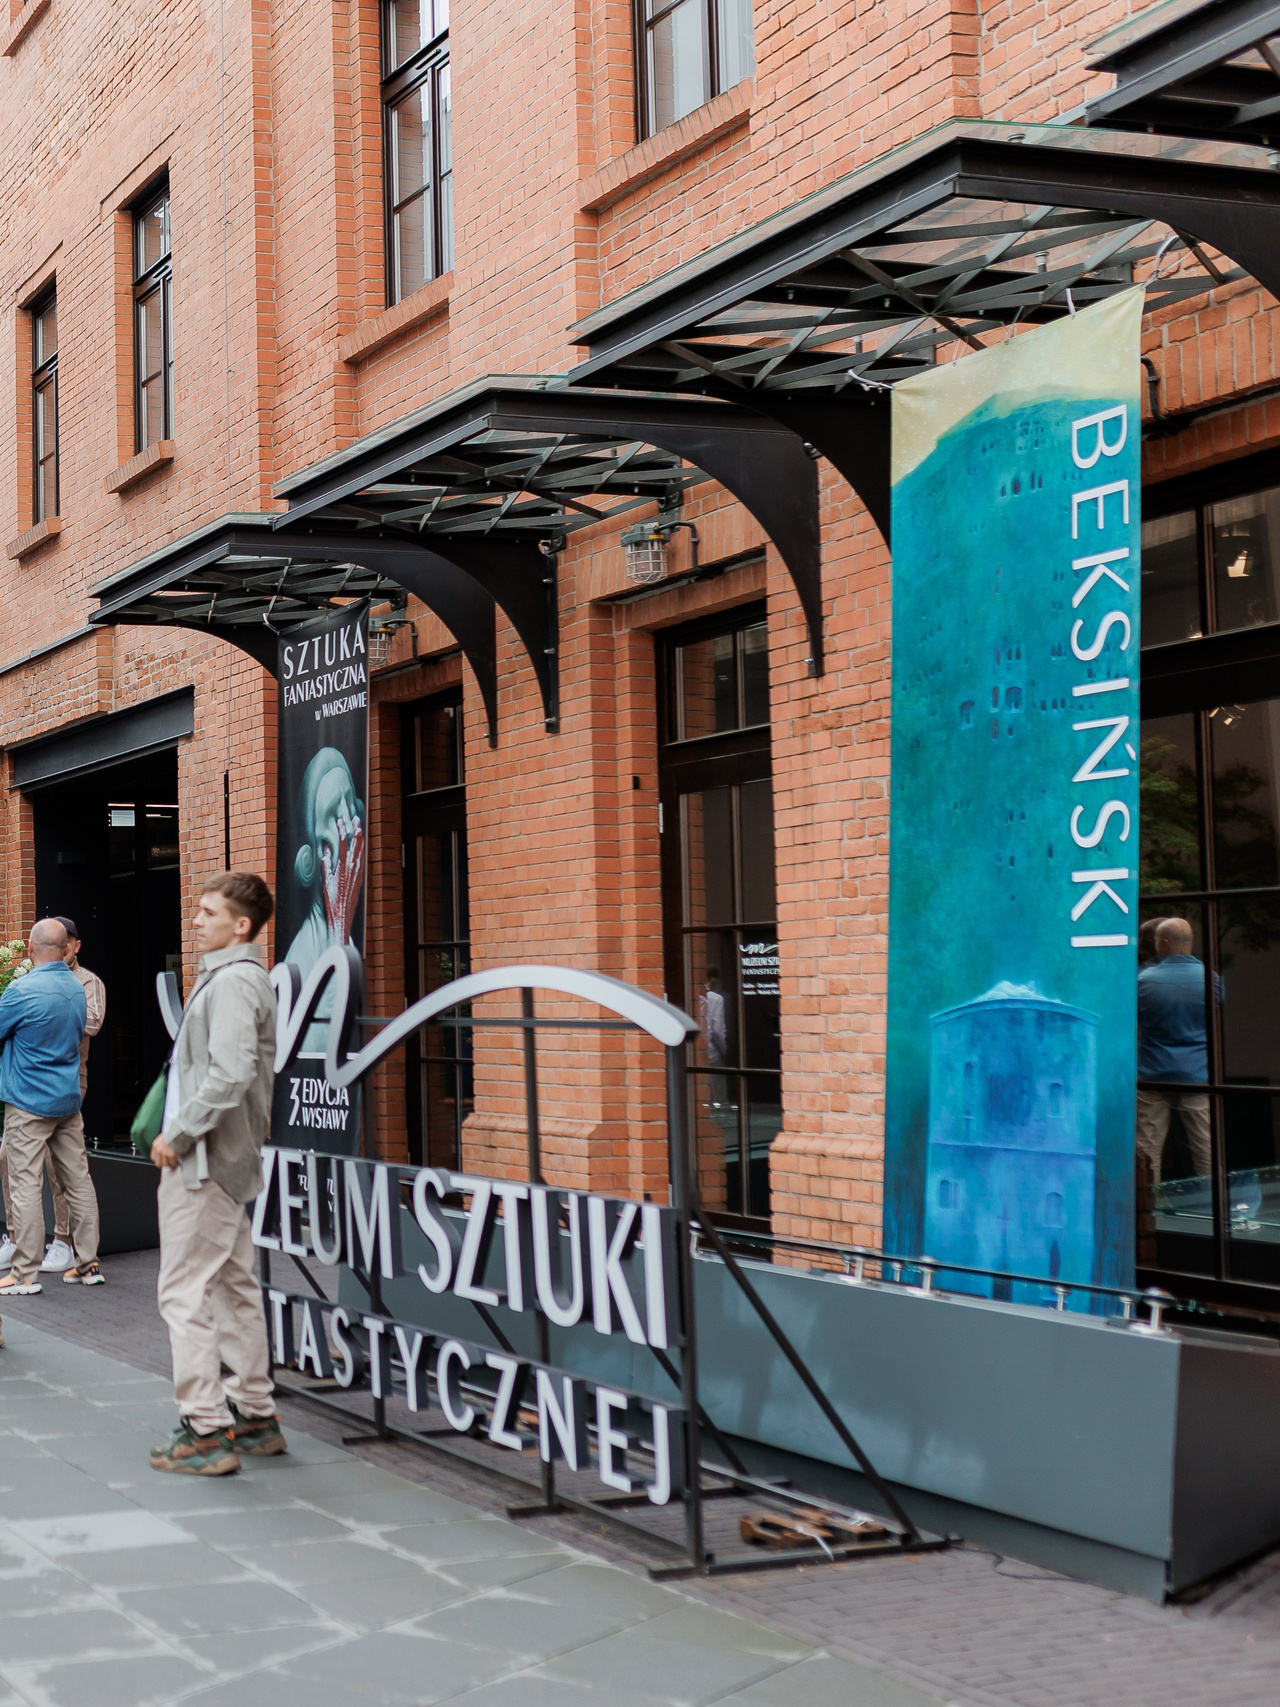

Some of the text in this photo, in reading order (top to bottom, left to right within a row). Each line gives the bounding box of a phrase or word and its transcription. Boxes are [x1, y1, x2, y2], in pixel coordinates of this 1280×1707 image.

[283, 621, 366, 680] SZTUKA
[1070, 404, 1136, 948] BEKSIŃSKI
[284, 662, 367, 707] FANTASTYCZNA
[322, 691, 367, 718] WARSZAWIE
[302, 1078, 350, 1106] EDYCJA
[302, 1107, 349, 1130] WYSTAWY
[251, 1146, 671, 1349] ZEUM SZTUKI
[269, 1290, 674, 1506] TASTYCZNEJ
